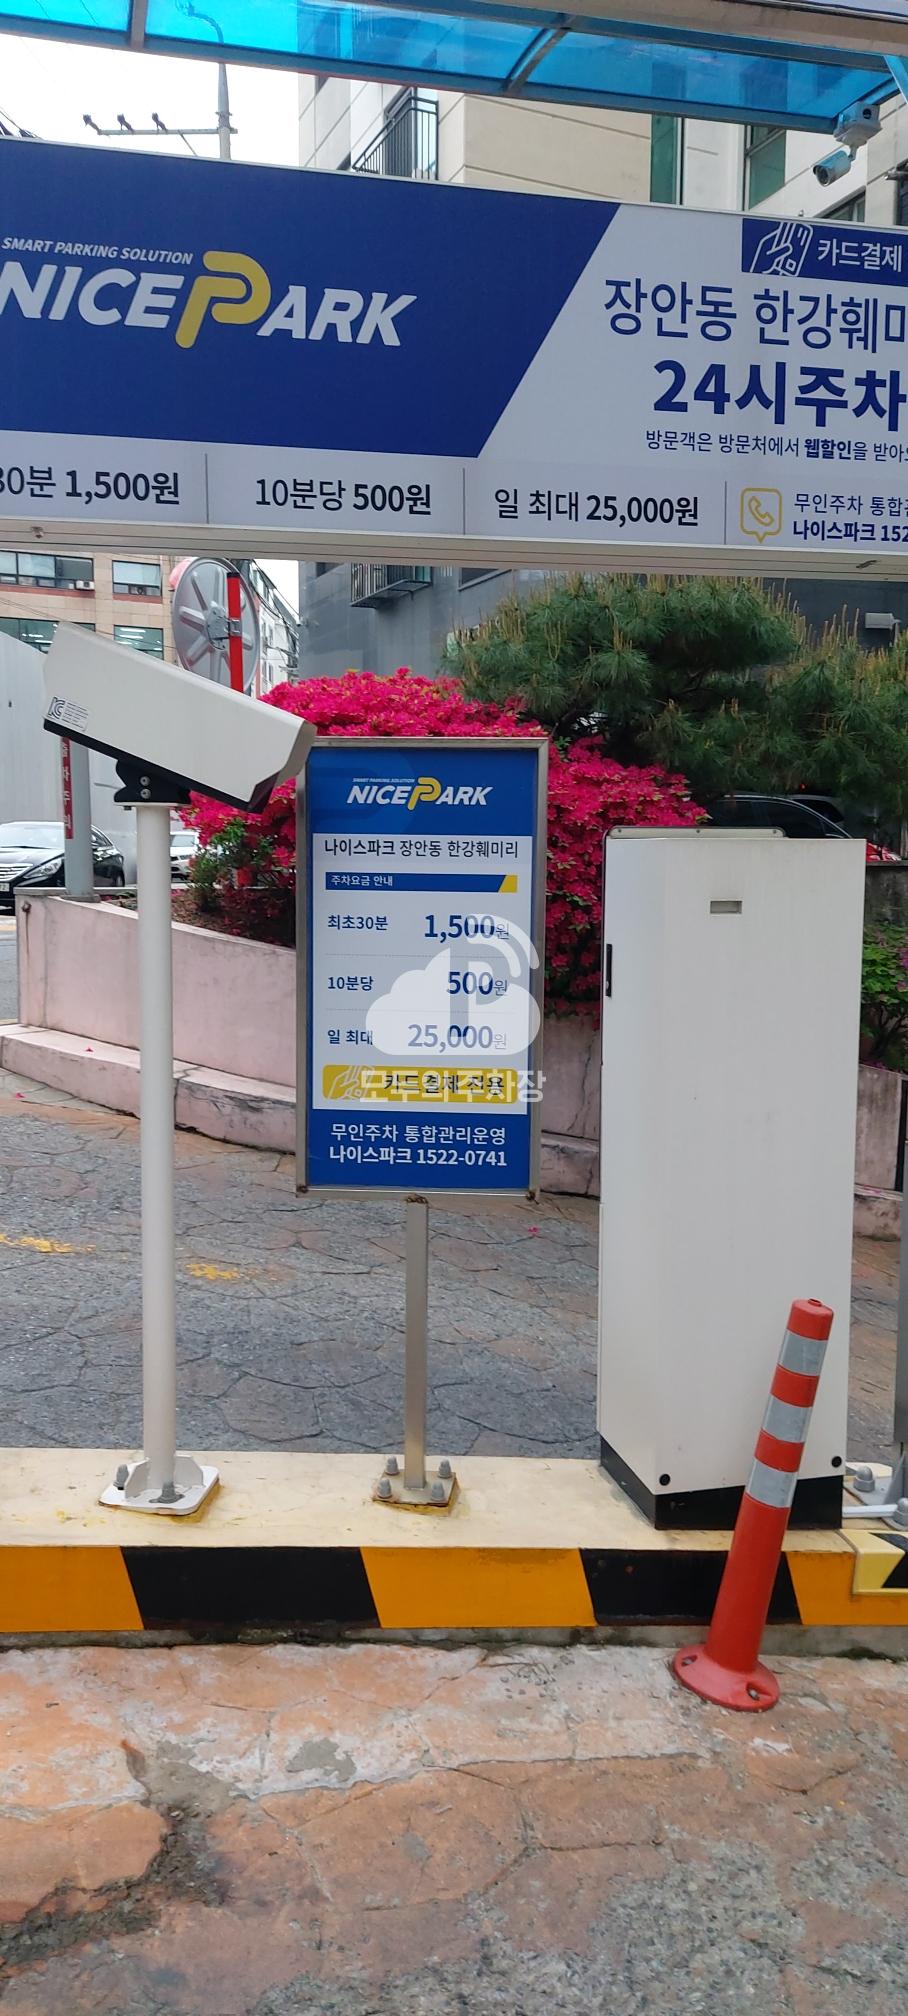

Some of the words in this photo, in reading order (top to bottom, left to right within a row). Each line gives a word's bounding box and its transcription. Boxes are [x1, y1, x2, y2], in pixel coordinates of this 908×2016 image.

[1, 237, 53, 253] SMART
[54, 241, 119, 259] PARKING
[120, 247, 193, 265] SOLUTION
[817, 238, 903, 273] 카드결제
[604, 277, 737, 342] 장안동
[646, 430, 713, 452] 방문객은
[719, 433, 799, 457] 방문처에서
[804, 438, 868, 461] 웹할인을
[873, 442, 908, 463] 받아
[65, 470, 180, 505] 1,500원
[255, 478, 346, 512] 10분당
[352, 483, 432, 516] 500원
[494, 488, 519, 520] 일
[528, 489, 579, 522] 최대
[586, 494, 699, 528] 25,000원
[794, 493, 863, 515] 무인주차
[793, 519, 876, 542] 나이스파크
[325, 838, 396, 857] 나이스파크
[399, 840, 442, 858] 장안동
[447, 840, 519, 859] 한강훼미리
[330, 875, 371, 888] 주차요금
[373, 876, 394, 888] 안내
[327, 915, 389, 931] 최초30분
[327, 975, 374, 992] 10분당
[327, 1029, 341, 1045] 일
[330, 1123, 399, 1143] 무인주차
[403, 1125, 507, 1145] 통합관리운영
[328, 1145, 413, 1165] 나이스파크
[416, 1148, 508, 1167] 1522-0741
